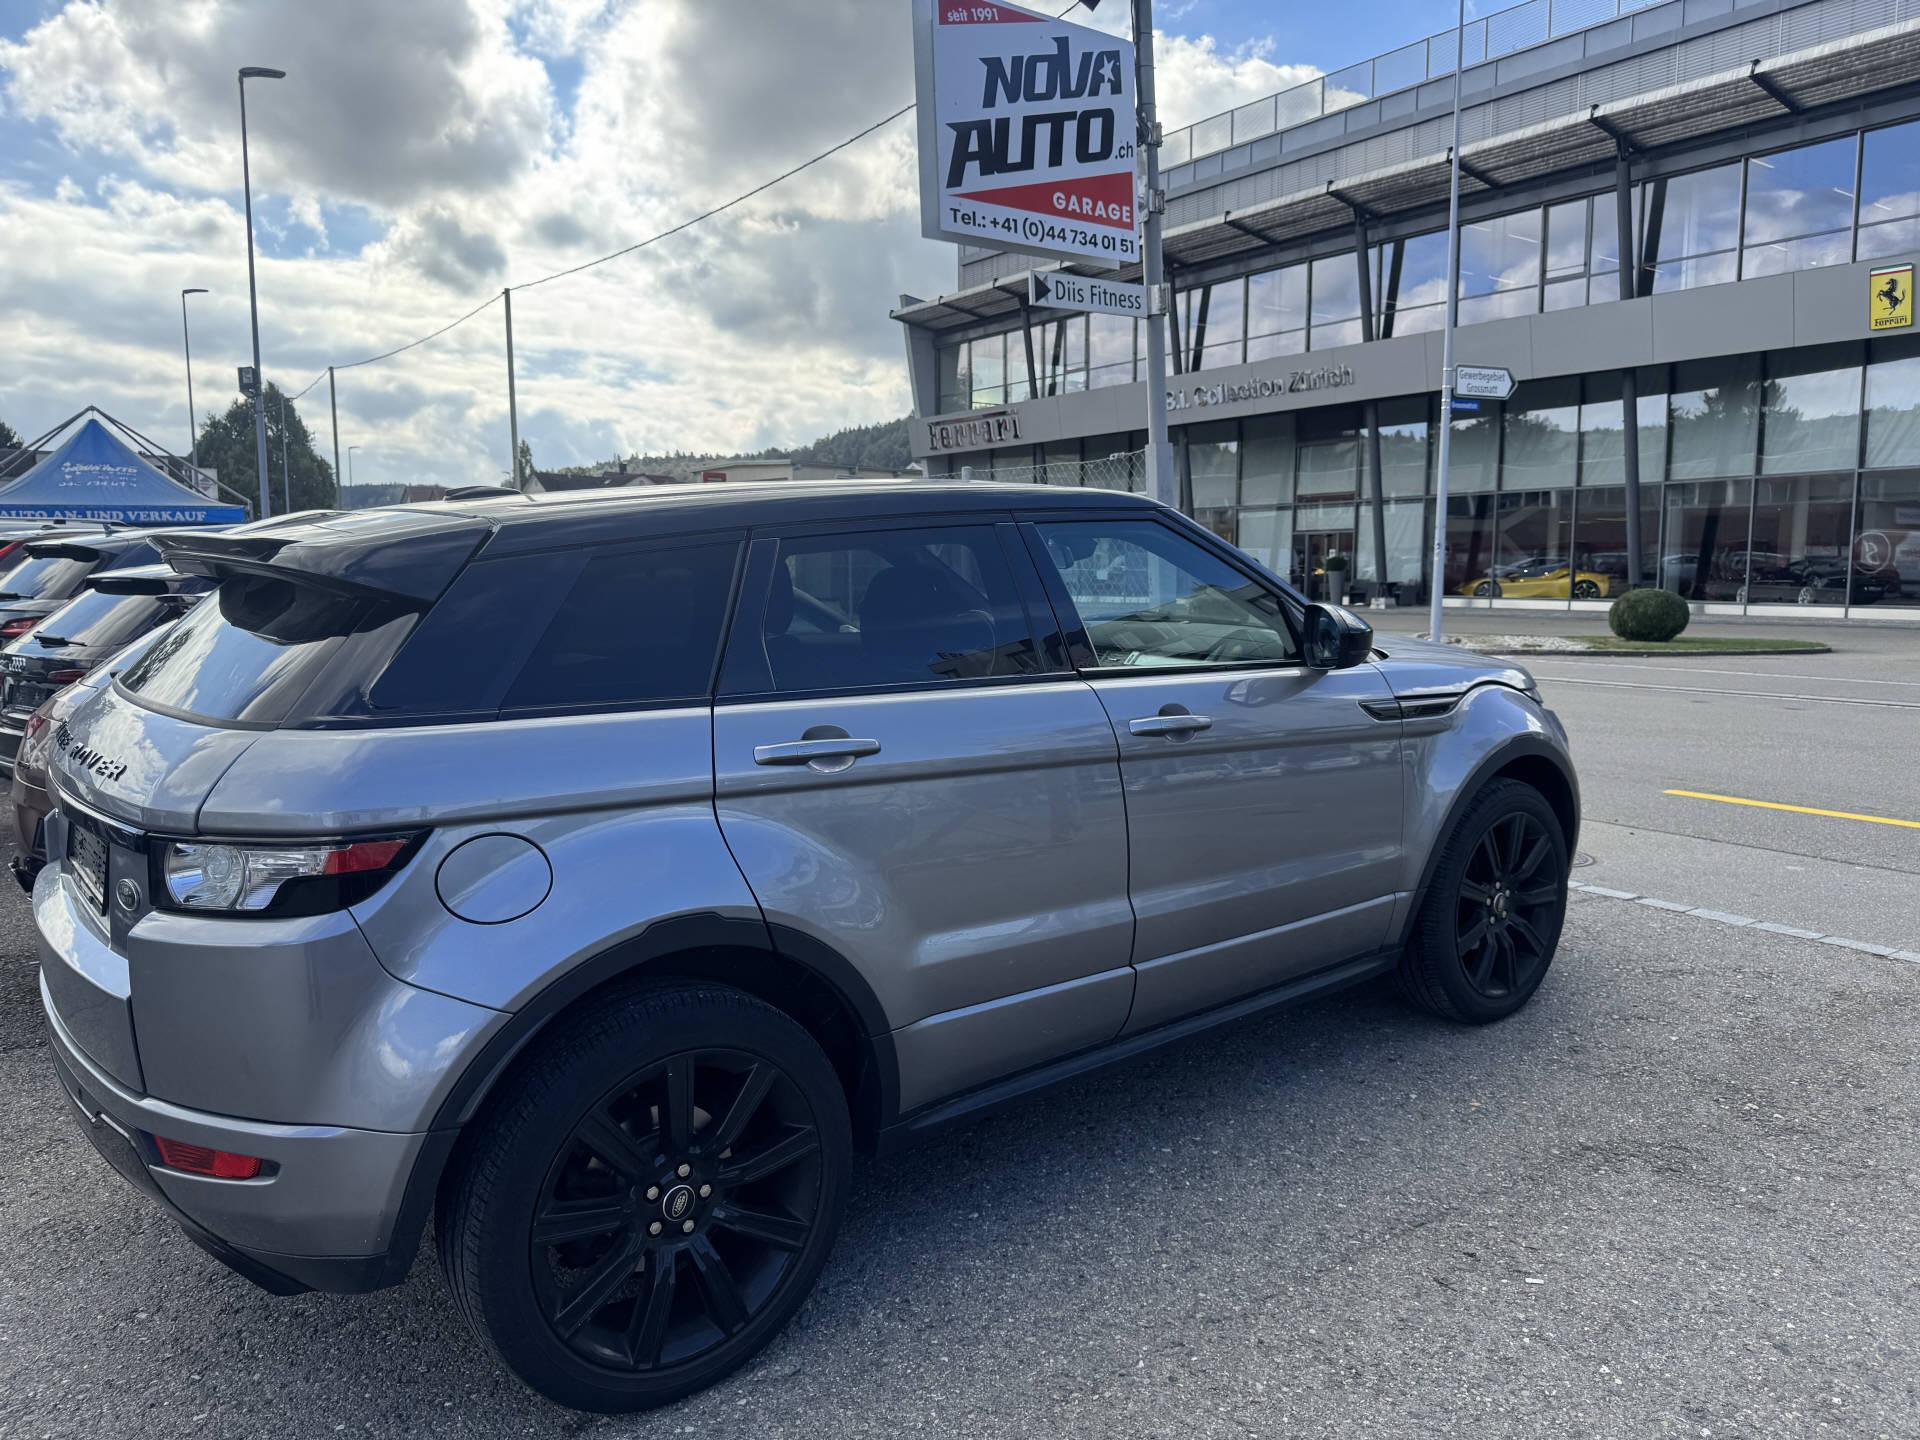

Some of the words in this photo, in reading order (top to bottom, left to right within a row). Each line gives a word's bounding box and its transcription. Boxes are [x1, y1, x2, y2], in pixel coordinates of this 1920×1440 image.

[947, 8, 968, 22] seit
[971, 7, 999, 21] 1991
[978, 36, 1122, 109] NOVA
[1053, 191, 1131, 223] GARAGE
[950, 207, 986, 229] Tel.:
[990, 216, 1018, 234] +41
[1070, 229, 1098, 249] 734
[1101, 234, 1116, 251] 01
[1055, 279, 1084, 304] Diis
[1090, 285, 1142, 311] Fitness
[1874, 316, 1907, 326] Ferrari
[1194, 377, 1284, 407] Collection
[927, 408, 1021, 451] Ferrari
[127, 511, 207, 522] VERKAUF
